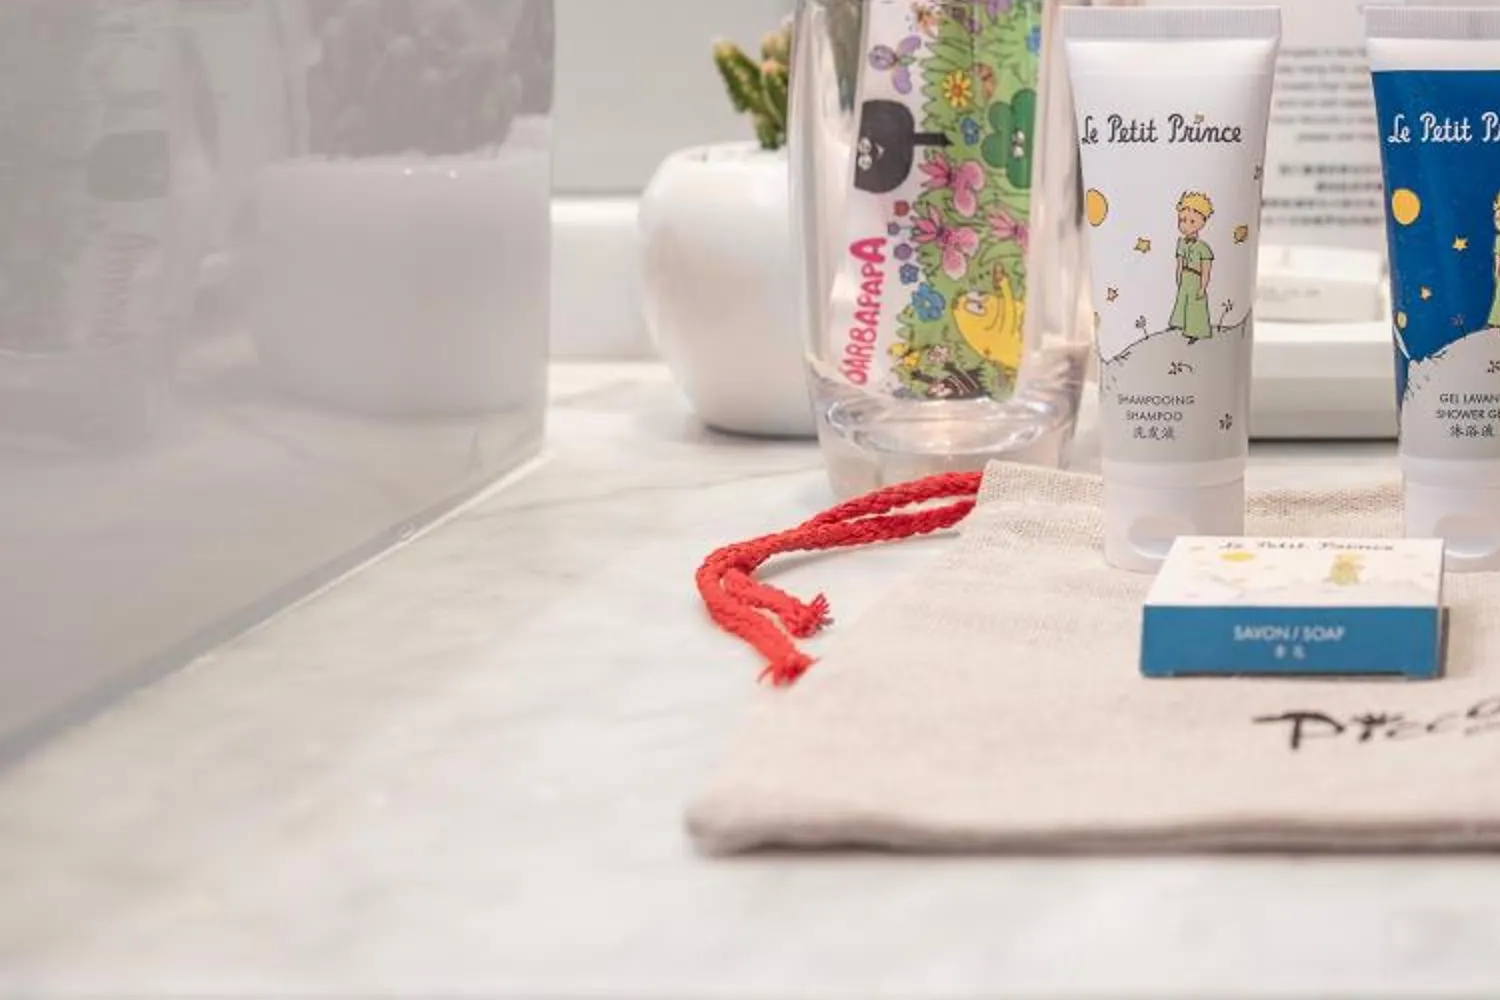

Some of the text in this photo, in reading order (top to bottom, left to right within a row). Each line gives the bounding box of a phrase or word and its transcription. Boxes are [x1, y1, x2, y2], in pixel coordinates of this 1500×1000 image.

[1081, 112, 1242, 144] Le Petit Prince
[1387, 113, 1411, 143] Le
[1419, 111, 1473, 143] Petit
[1117, 394, 1195, 406] SHAMPOOING
[1439, 393, 1459, 404] GEL
[1126, 410, 1184, 421] SHAMPOO
[1436, 408, 1485, 420] SHOWER
[1233, 625, 1289, 641] SAVON
[1302, 625, 1346, 641] SOAP
